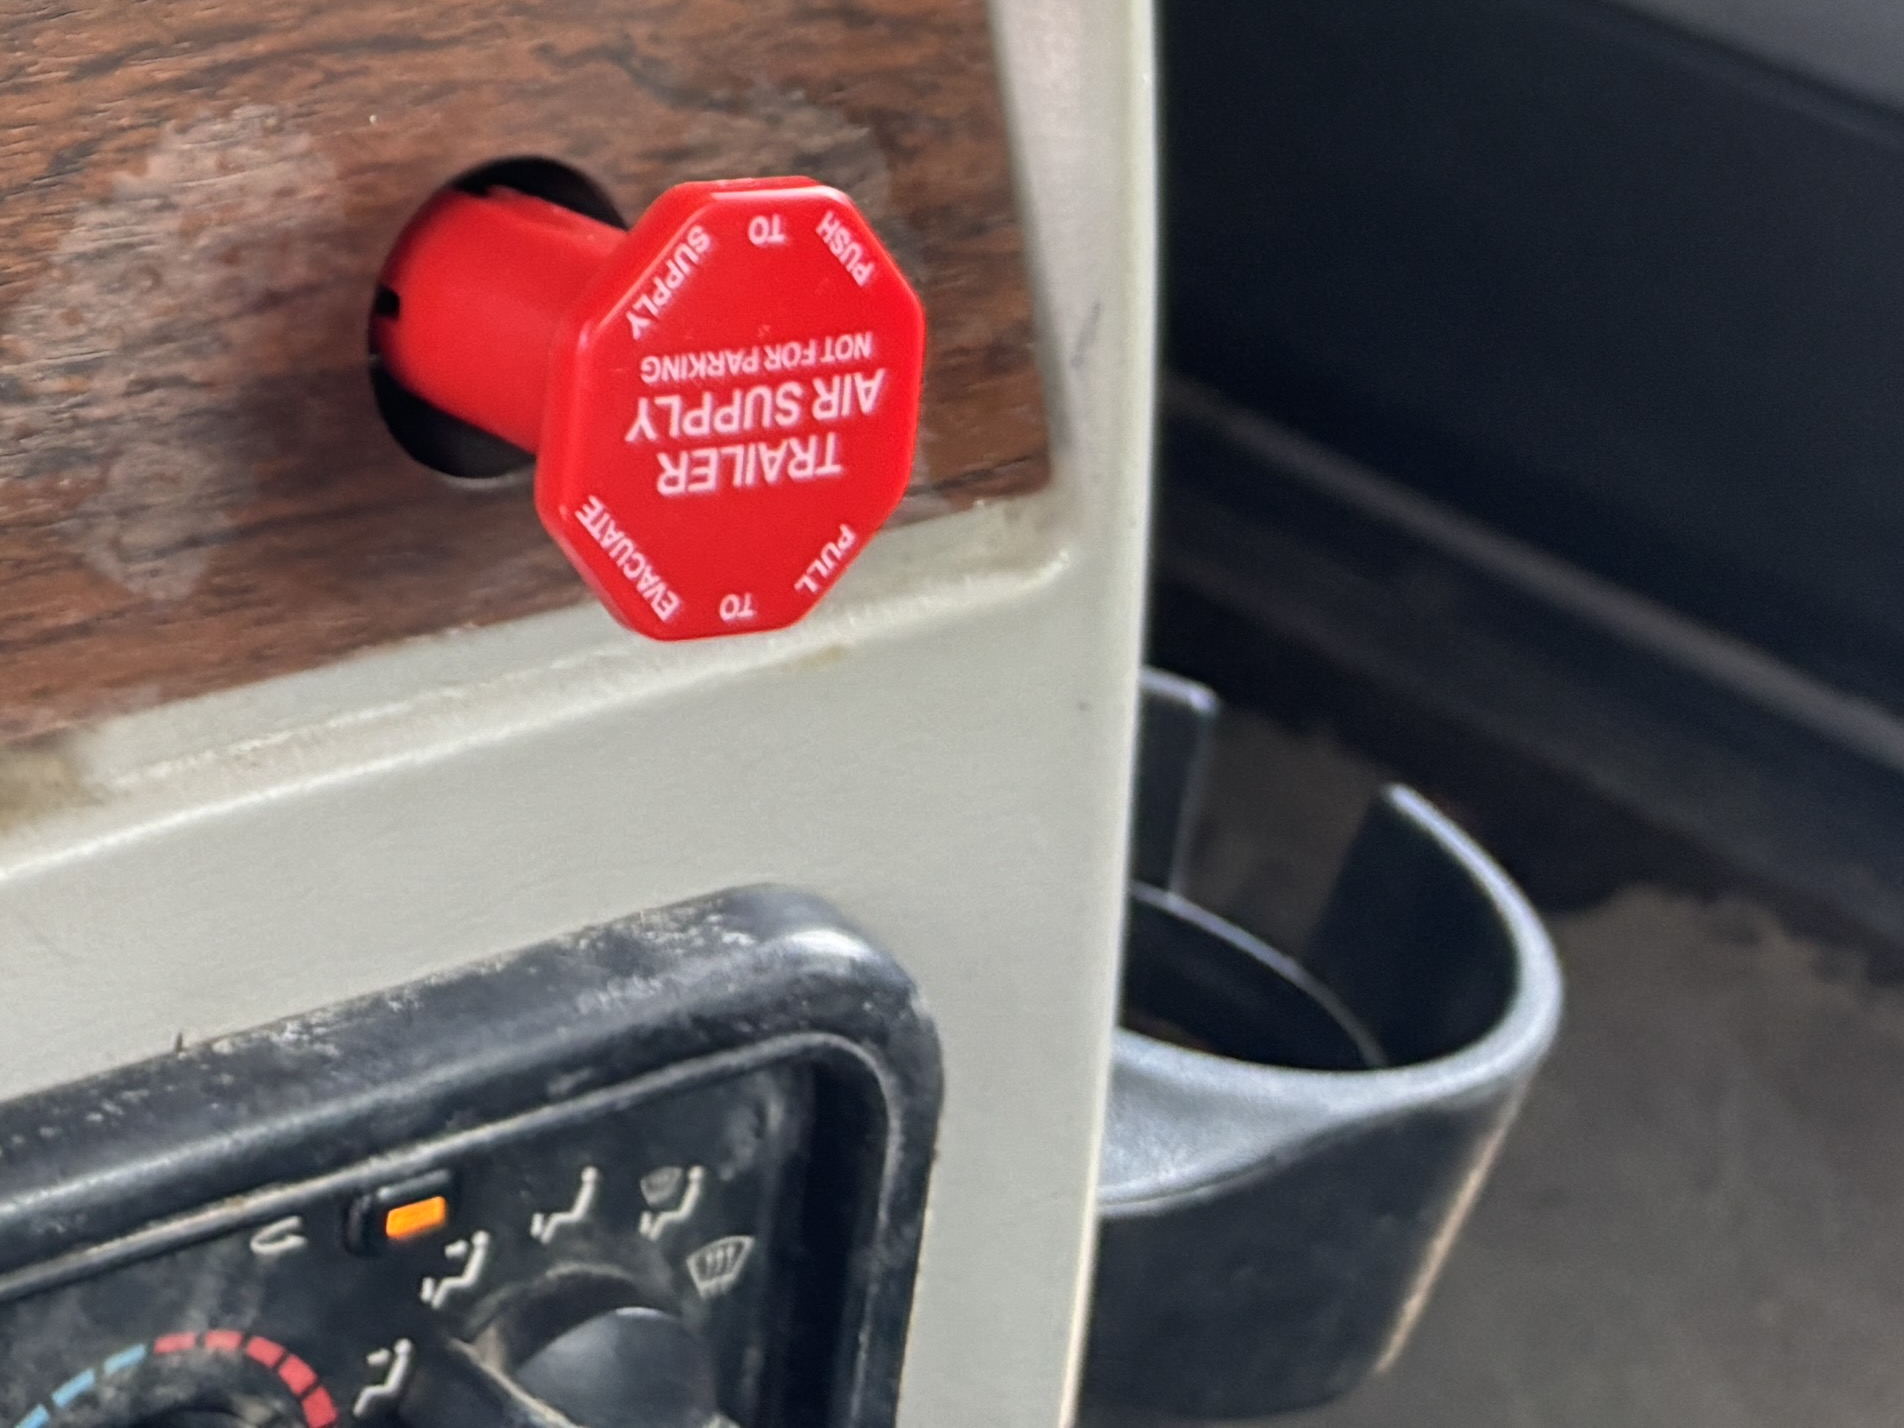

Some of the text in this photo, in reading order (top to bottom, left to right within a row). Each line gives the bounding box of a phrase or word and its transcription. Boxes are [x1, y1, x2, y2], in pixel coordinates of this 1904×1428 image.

[625, 210, 876, 340] PUSH TO SUPPLY
[640, 331, 874, 384] NOT FOR PARKING
[624, 367, 887, 444] AIR SUPPLY
[656, 432, 843, 497] TRAILER
[574, 494, 857, 622] PULL TO EVACUATE
